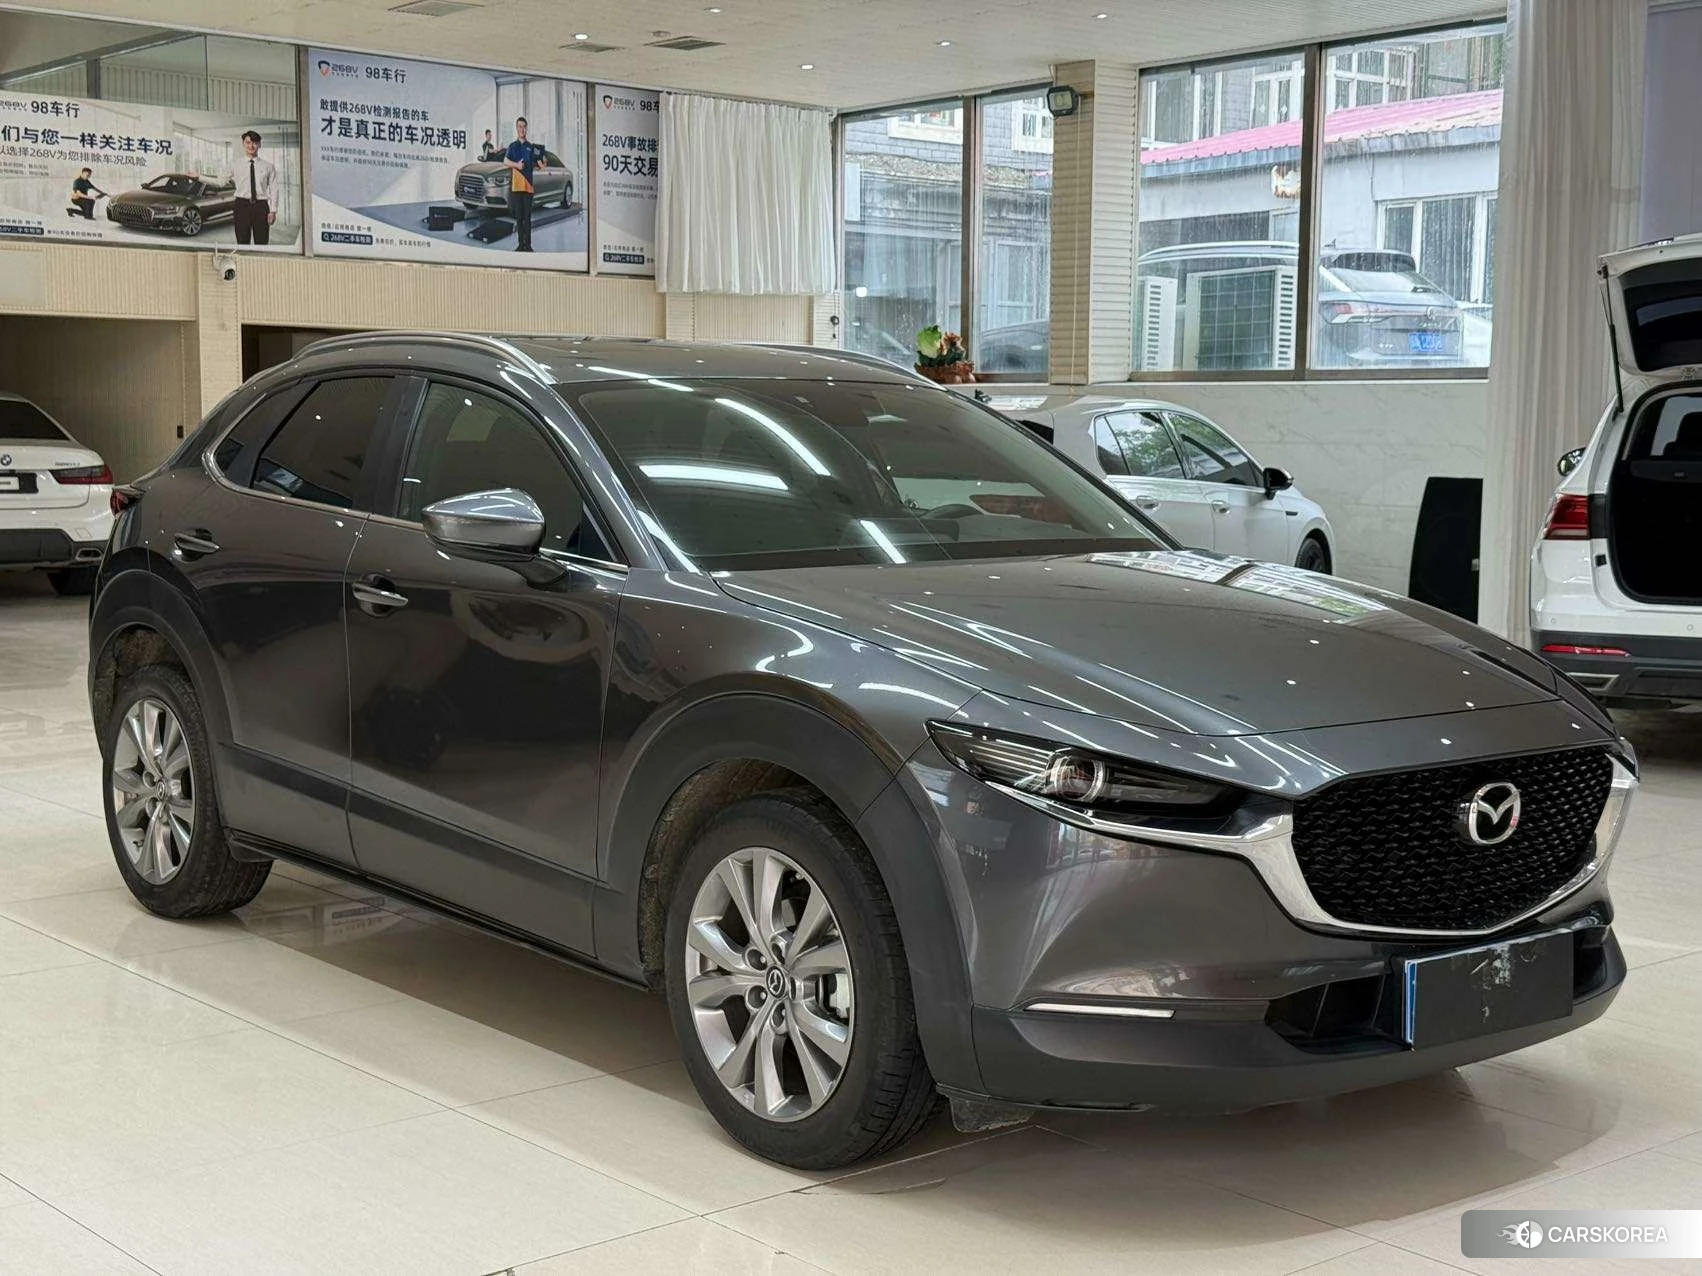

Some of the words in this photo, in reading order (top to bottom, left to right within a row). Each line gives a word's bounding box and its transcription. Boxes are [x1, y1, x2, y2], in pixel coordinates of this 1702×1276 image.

[365, 67, 407, 84] 98车行
[31, 101, 80, 118] 98车行
[1, 125, 173, 156] 们与您一样关注车况
[320, 116, 467, 149] 才是真正的车况透明
